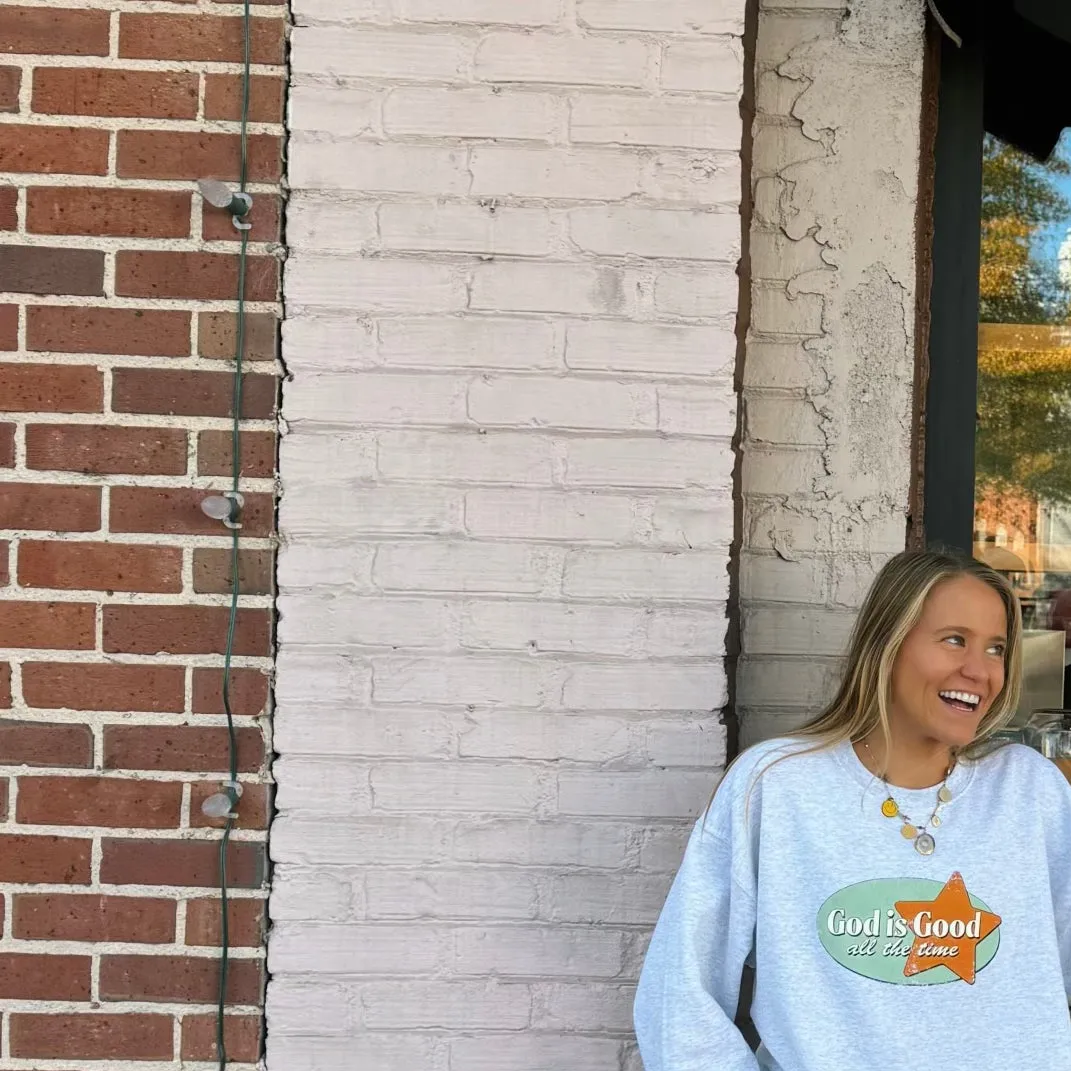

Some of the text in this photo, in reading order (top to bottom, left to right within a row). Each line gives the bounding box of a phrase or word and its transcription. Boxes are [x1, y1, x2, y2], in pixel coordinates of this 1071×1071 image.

[827, 908, 982, 939] God is Good
[846, 938, 960, 958] all the time
